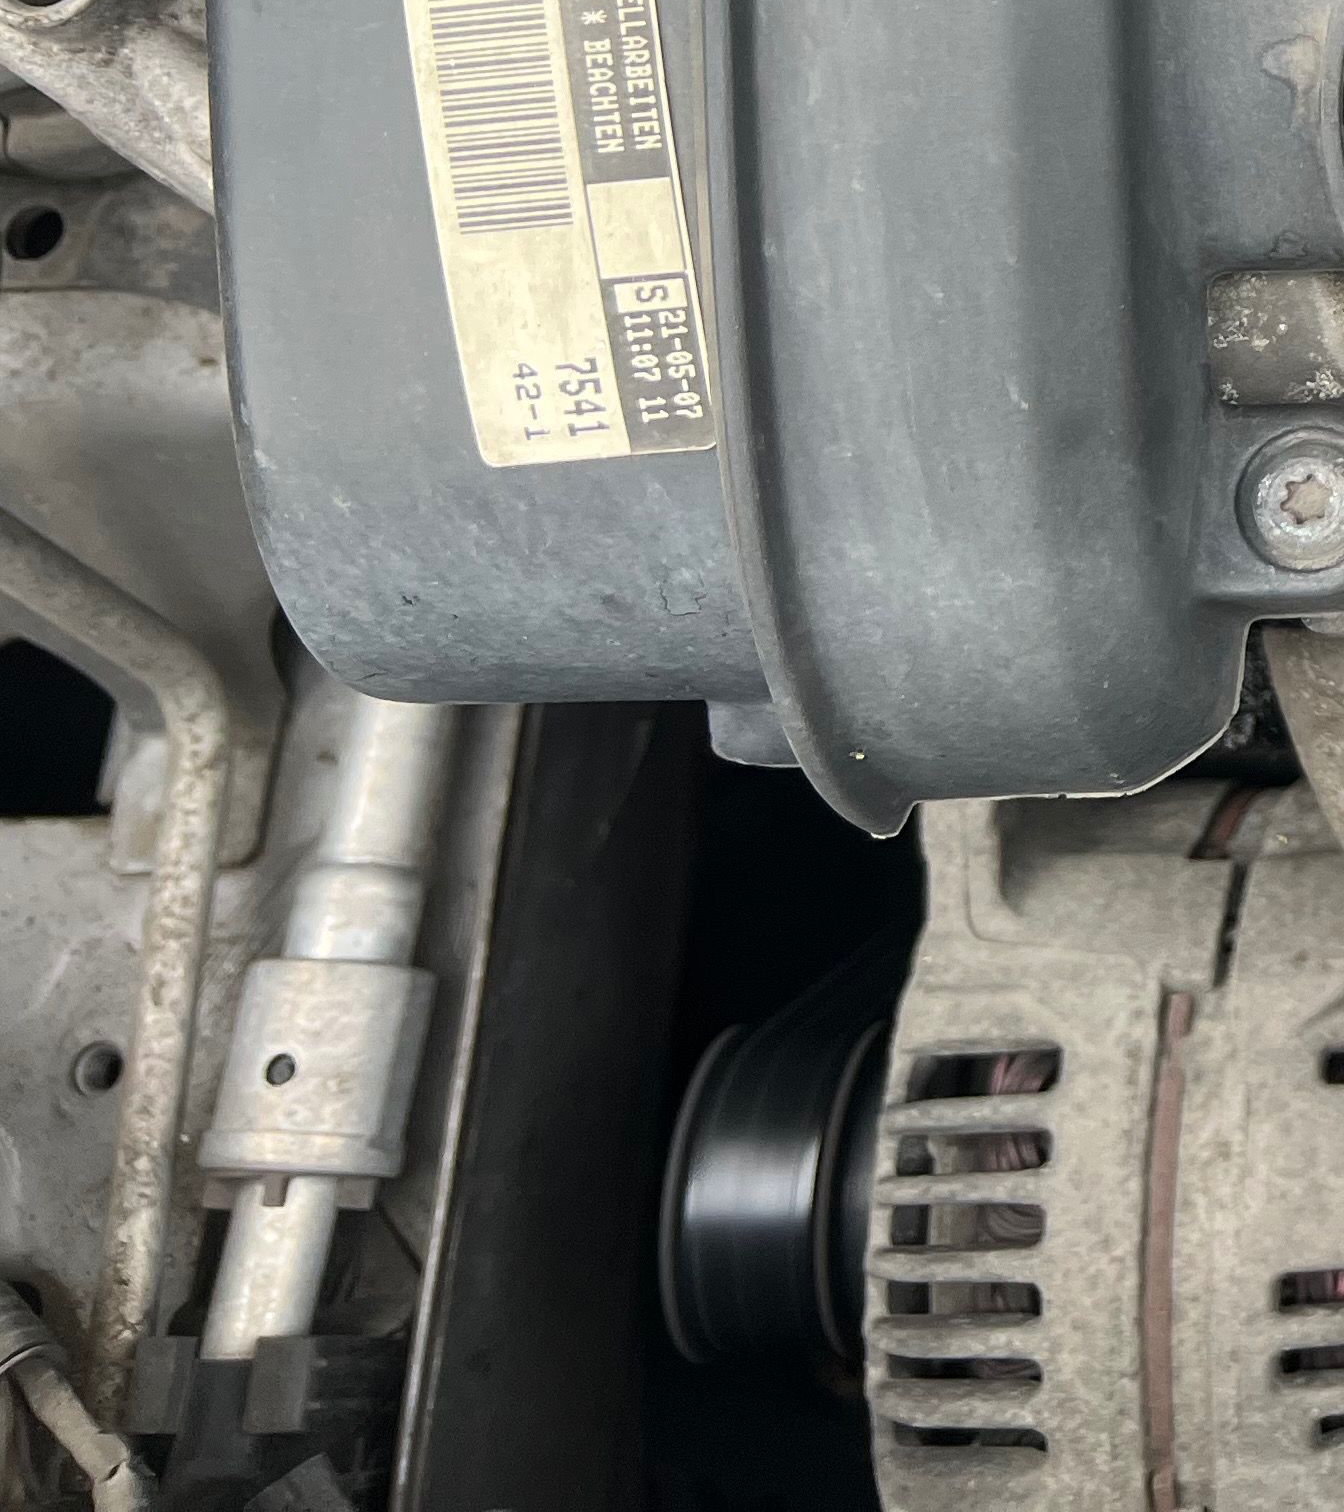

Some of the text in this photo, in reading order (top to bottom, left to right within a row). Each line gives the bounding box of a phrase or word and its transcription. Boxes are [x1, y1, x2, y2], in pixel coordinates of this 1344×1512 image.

[581, 38, 625, 154] BEACHTEN
[633, 284, 668, 303] S
[511, 362, 551, 441] 42-1
[554, 357, 610, 438] 7541
[622, 313, 669, 424] 11:07 11
[657, 309, 703, 419] 21-05-07
